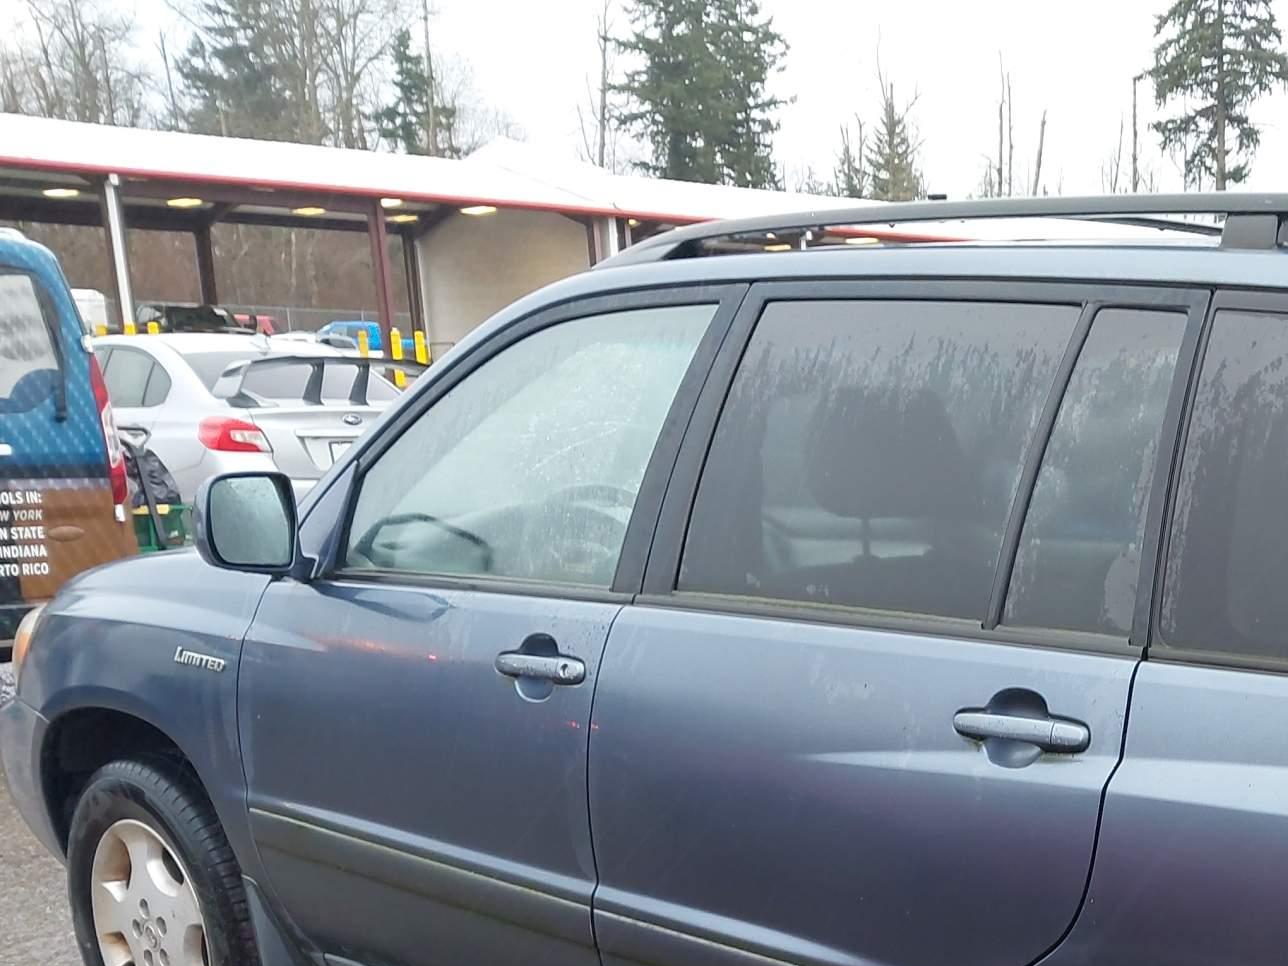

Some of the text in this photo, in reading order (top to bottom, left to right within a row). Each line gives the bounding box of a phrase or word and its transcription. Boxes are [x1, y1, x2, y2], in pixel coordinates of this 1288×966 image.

[0, 490, 42, 505] OLS IN:
[13, 508, 43, 521] YORK
[11, 526, 45, 540] STATE
[0, 544, 47, 559] INDIANA
[22, 562, 49, 576] RICO
